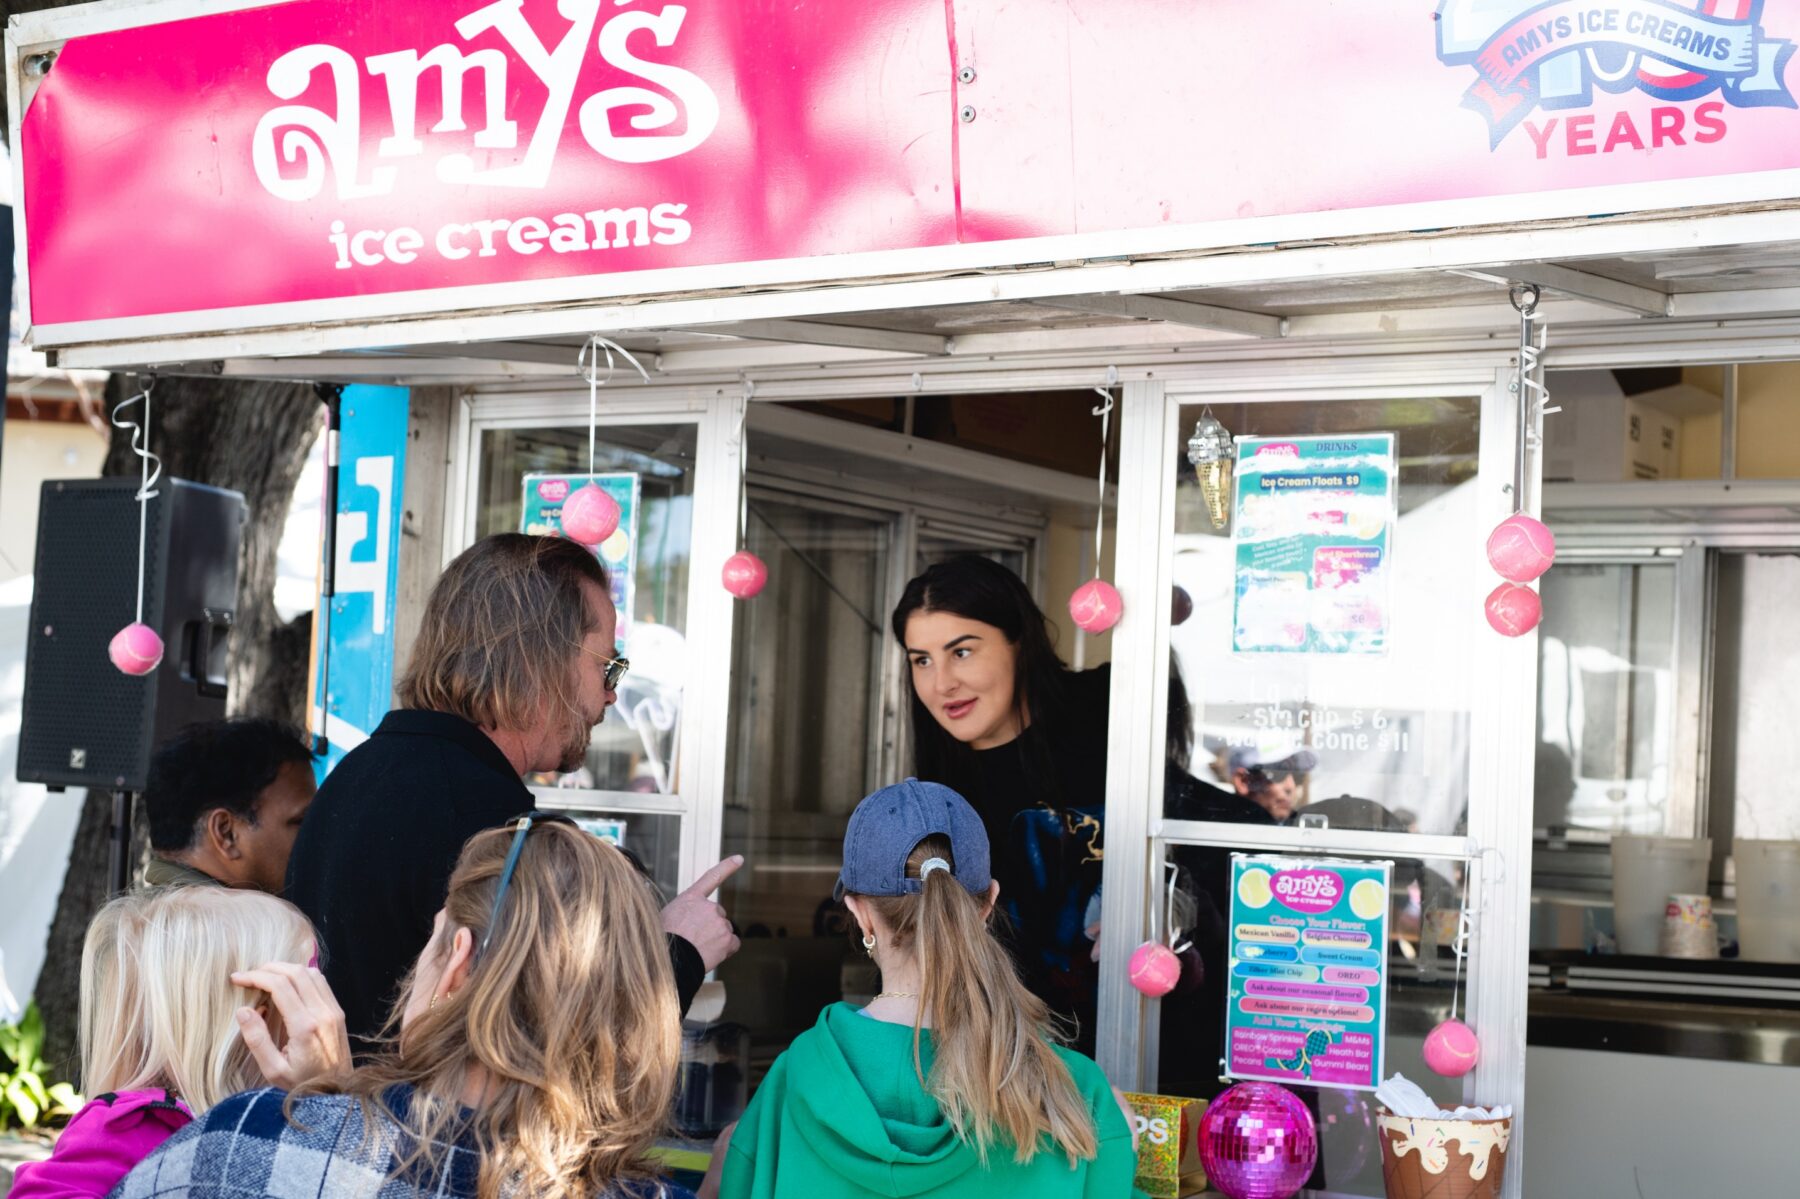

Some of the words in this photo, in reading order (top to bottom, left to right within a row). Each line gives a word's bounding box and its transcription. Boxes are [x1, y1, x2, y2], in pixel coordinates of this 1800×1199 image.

[1501, 15, 1572, 68] AMYS
[1578, 9, 1619, 34] ICE
[1625, 10, 1732, 61] CREAMS
[1522, 101, 1728, 160] YEARS
[329, 220, 424, 269] ice
[435, 203, 692, 260] creams
[1315, 442, 1358, 452] DRINKS
[1261, 478, 1276, 487] Ice
[1277, 477, 1311, 487] Cream
[1312, 475, 1342, 486] Floats
[1345, 474, 1360, 485] $9
[1311, 732, 1369, 751] cone
[1240, 928, 1269, 937] Mexican
[1270, 929, 1296, 938] Vanilla
[1307, 933, 1331, 941] Belgian
[1333, 934, 1367, 943] Chocolate
[1318, 952, 1338, 960] Sweet
[1340, 953, 1363, 961] Cream
[1287, 968, 1303, 976] Chip
[1251, 983, 1264, 991] Ask
[1266, 984, 1287, 993] about
[1254, 1001, 1268, 1009] Ask
[1269, 1003, 1290, 1011] about
[1233, 1030, 1268, 1041] Rainbow
[1269, 1032, 1305, 1045] Sprinkles
[1262, 1045, 1294, 1056] Cookies
[1329, 1048, 1353, 1056] Heath
[1355, 1049, 1370, 1058] Bar
[1233, 1056, 1262, 1066] Pecans
[1314, 1059, 1345, 1069] Gummi
[1346, 1062, 1369, 1071] Bears
